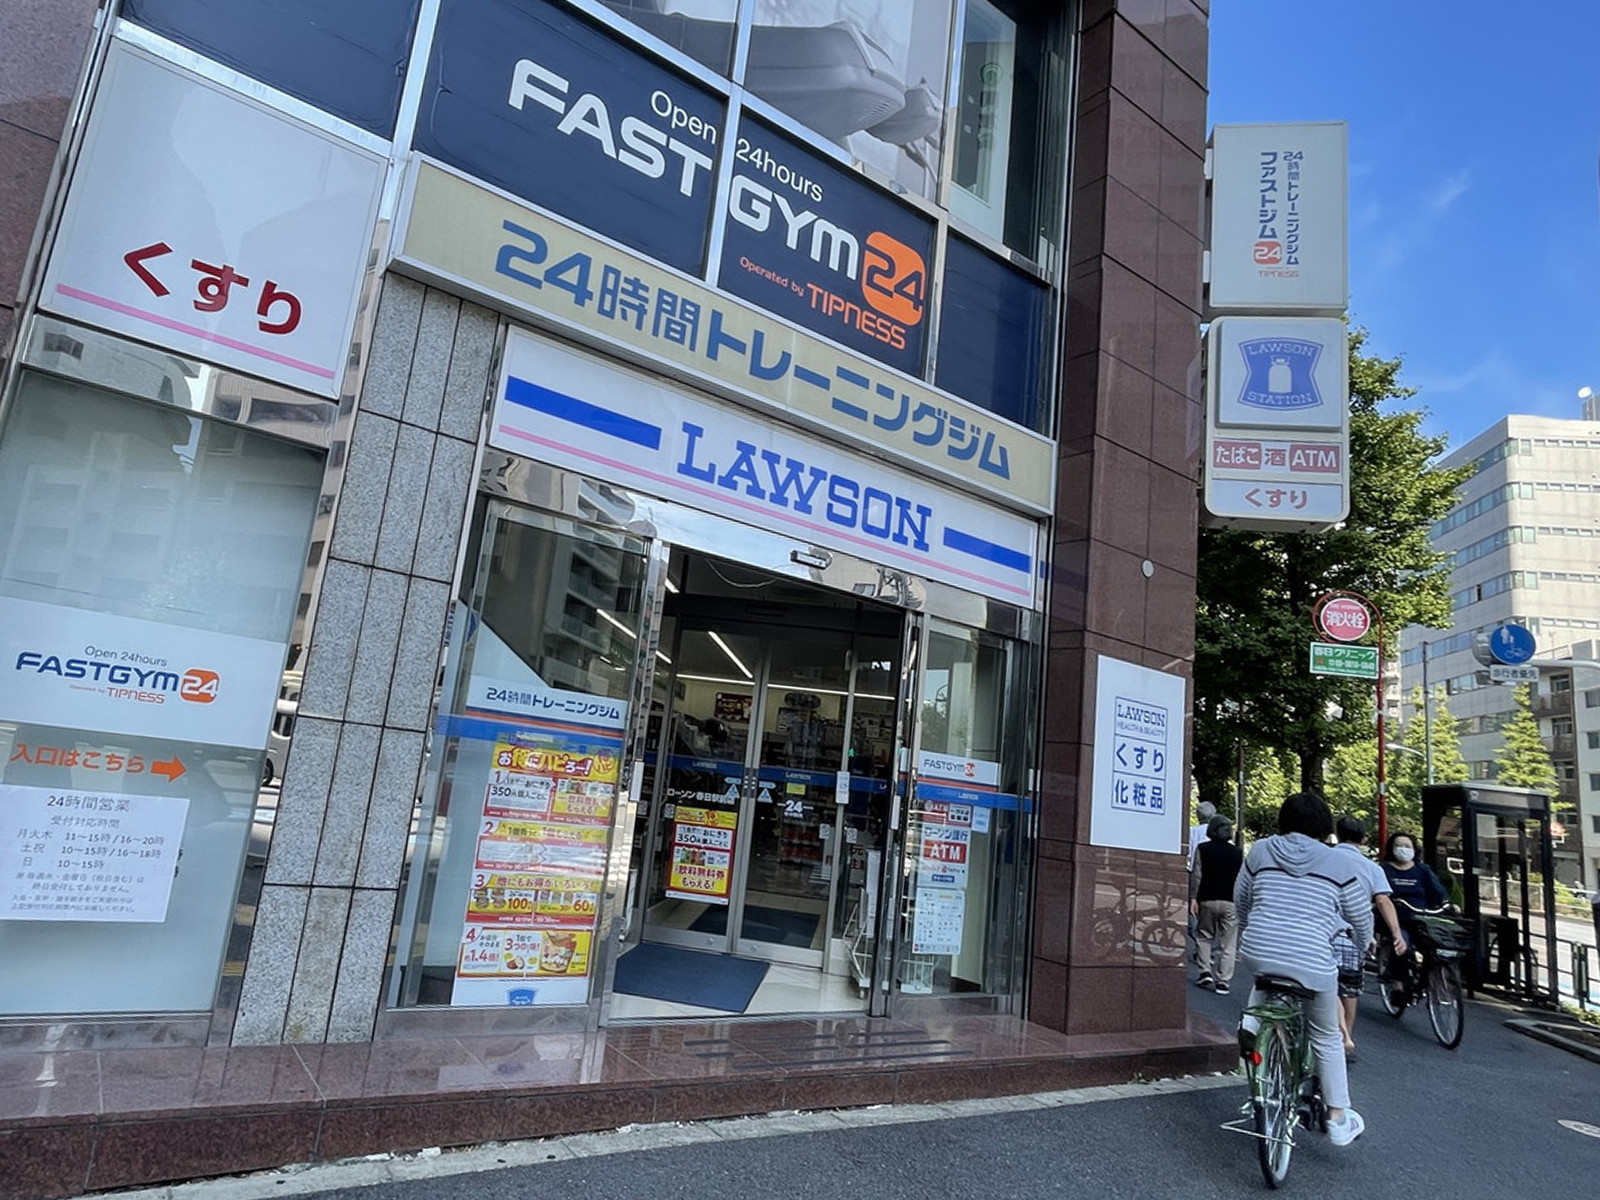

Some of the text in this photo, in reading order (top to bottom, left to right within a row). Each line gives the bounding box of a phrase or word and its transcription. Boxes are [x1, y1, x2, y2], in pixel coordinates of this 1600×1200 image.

[508, 58, 713, 198] FAST
[651, 90, 823, 202] Open 24hours
[123, 242, 302, 335] くすり
[740, 256, 788, 289] Operated
[791, 280, 804, 297] by
[495, 219, 1012, 481] 24時間トレーニングジム
[1248, 343, 1314, 358] LAWSON
[1247, 391, 1312, 405] STATION
[1215, 445, 1337, 468] たばこ 酒 ATM
[677, 422, 933, 552] LAWSON
[1244, 488, 1308, 510] くすり
[1326, 610, 1365, 629] 消火栓
[84, 645, 168, 667] Open 24hours
[486, 687, 620, 720] 24時間トレーニングジム
[1117, 703, 1166, 728] LAWSON
[10, 743, 146, 774] 入口はこちら
[1116, 742, 1164, 773] くすり
[47, 795, 131, 813] 24時間営業
[785, 800, 803, 813] 24
[1114, 779, 1163, 810] 化粧品
[930, 844, 960, 861] ATM
[475, 874, 485, 889] 3
[466, 928, 477, 944] 4
